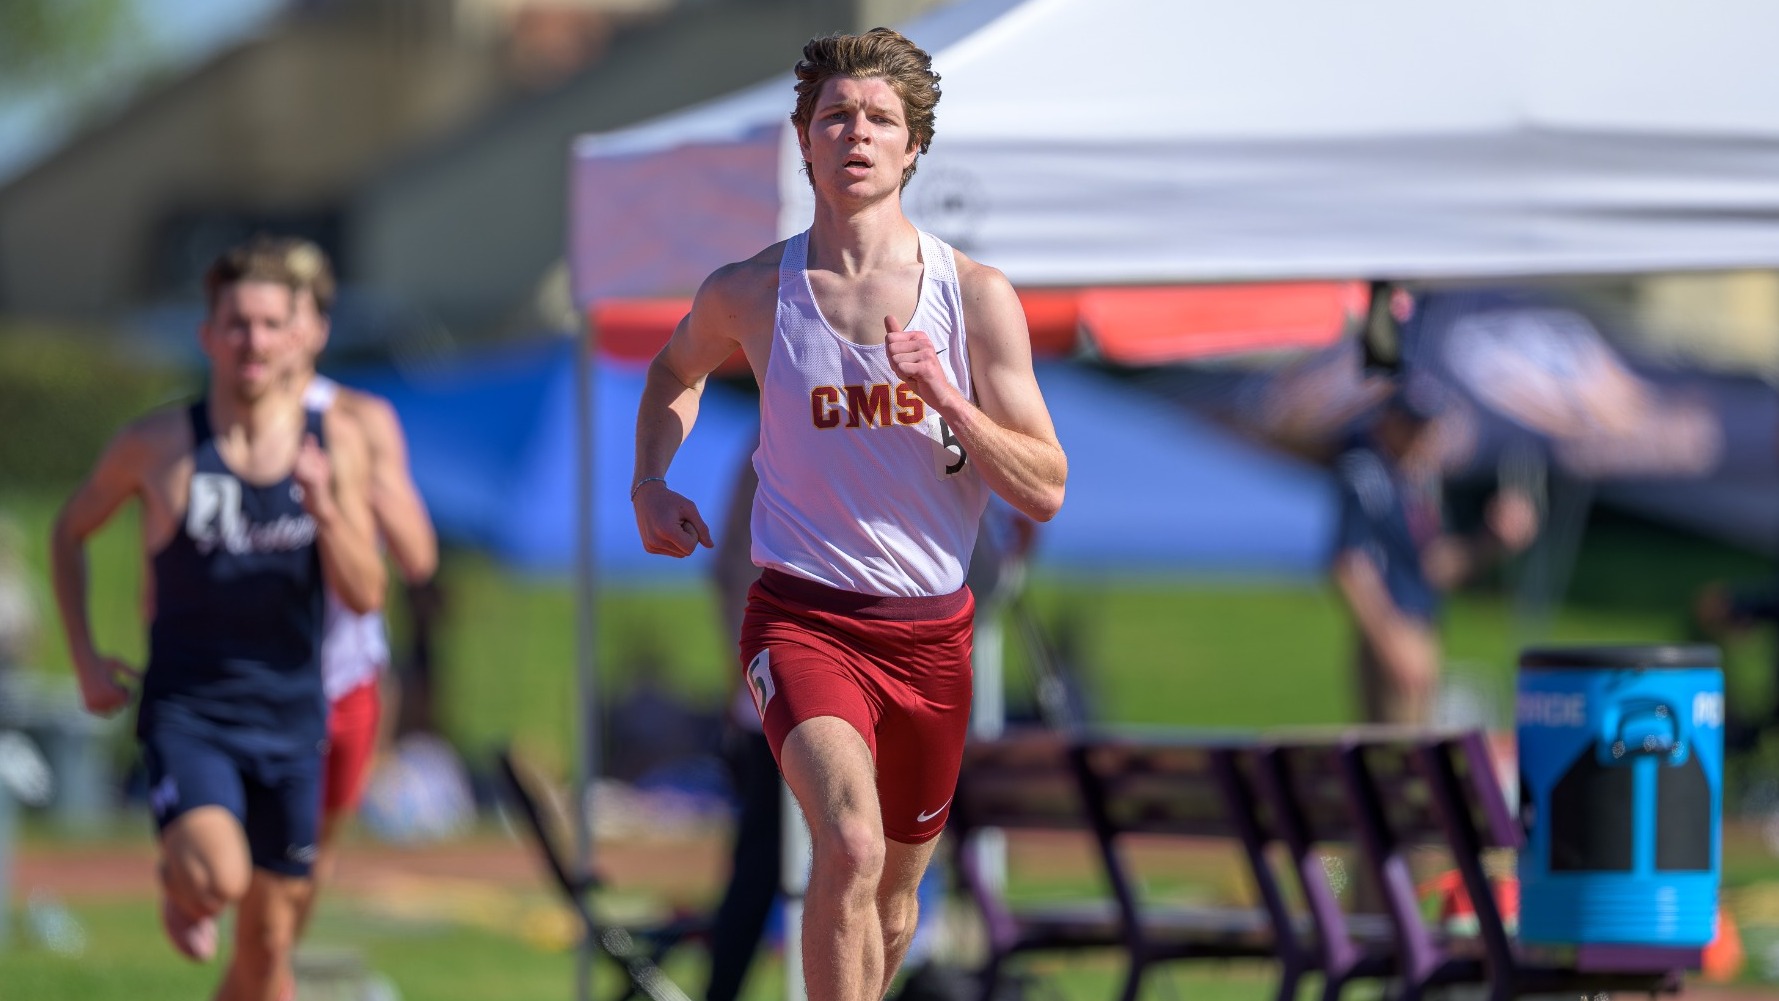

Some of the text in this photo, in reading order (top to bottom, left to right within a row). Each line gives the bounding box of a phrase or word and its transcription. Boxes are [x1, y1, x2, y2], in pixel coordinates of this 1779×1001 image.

[811, 381, 927, 430] CMS
[938, 416, 968, 475] 5
[748, 656, 767, 714] 5
